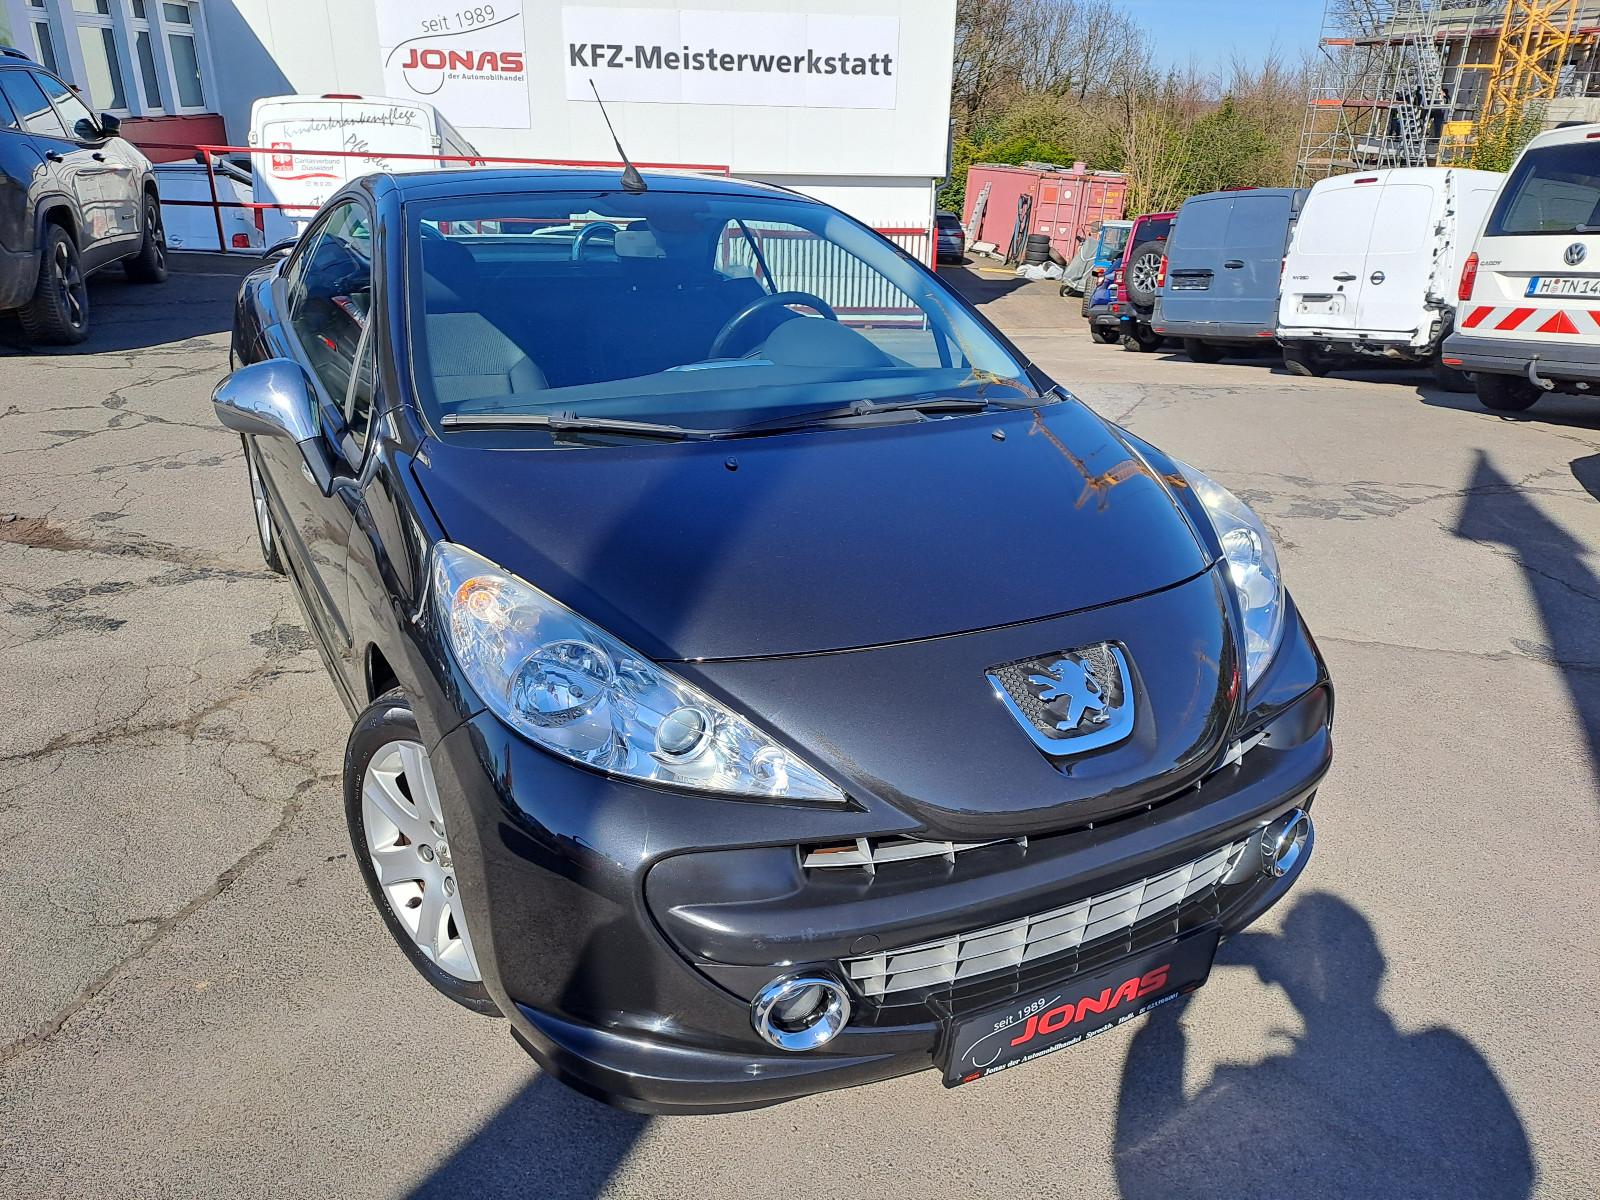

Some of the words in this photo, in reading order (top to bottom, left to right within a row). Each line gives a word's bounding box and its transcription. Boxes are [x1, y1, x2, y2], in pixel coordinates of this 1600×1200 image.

[421, 15, 450, 32] seit
[456, 5, 495, 27] 1989
[402, 48, 524, 72] JONAS
[569, 43, 893, 76] KFZ-Meisterwerkstatt
[461, 73, 525, 82] Automobilhandel
[1539, 279, 1553, 293] H
[1579, 280, 1600, 294] 14
[993, 1014, 1014, 1031] seit
[1017, 997, 1046, 1020] 1989
[1010, 964, 1171, 1046] JONAS
[983, 1063, 1006, 1076] Jonas
[1007, 1058, 1021, 1067] der
[1021, 1035, 1082, 1062] Automobilhandel
